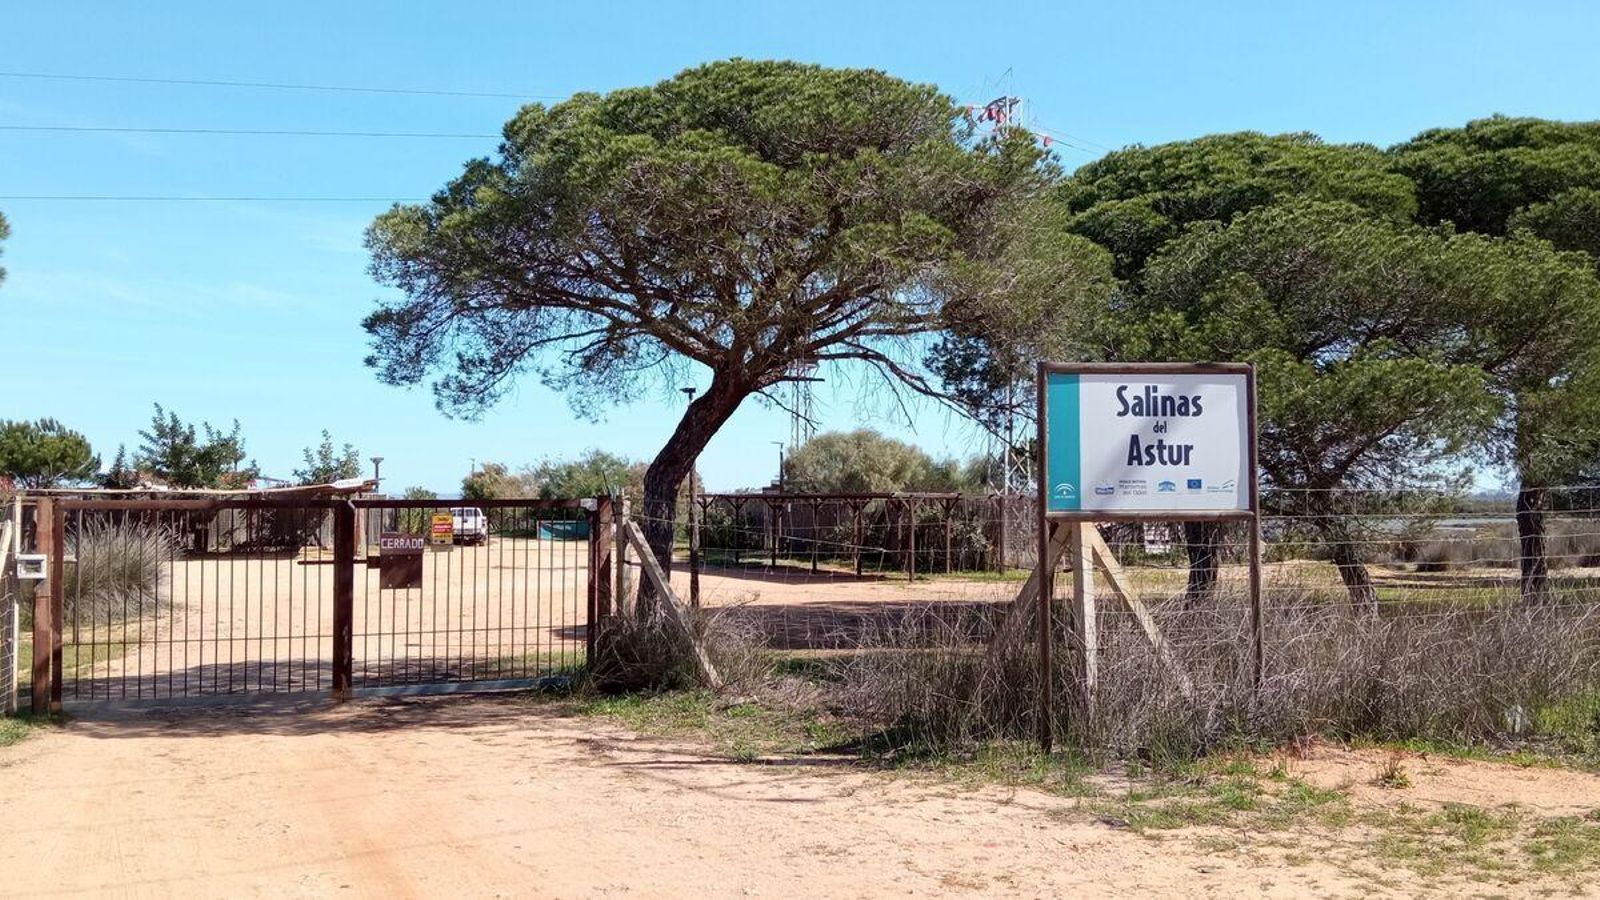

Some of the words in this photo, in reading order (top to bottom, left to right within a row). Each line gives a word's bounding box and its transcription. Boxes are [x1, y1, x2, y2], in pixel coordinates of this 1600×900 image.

[1116, 385, 1203, 417] Salinas
[1153, 421, 1167, 433] del
[1127, 434, 1194, 466] Astur
[380, 538, 424, 549] CERRADO
